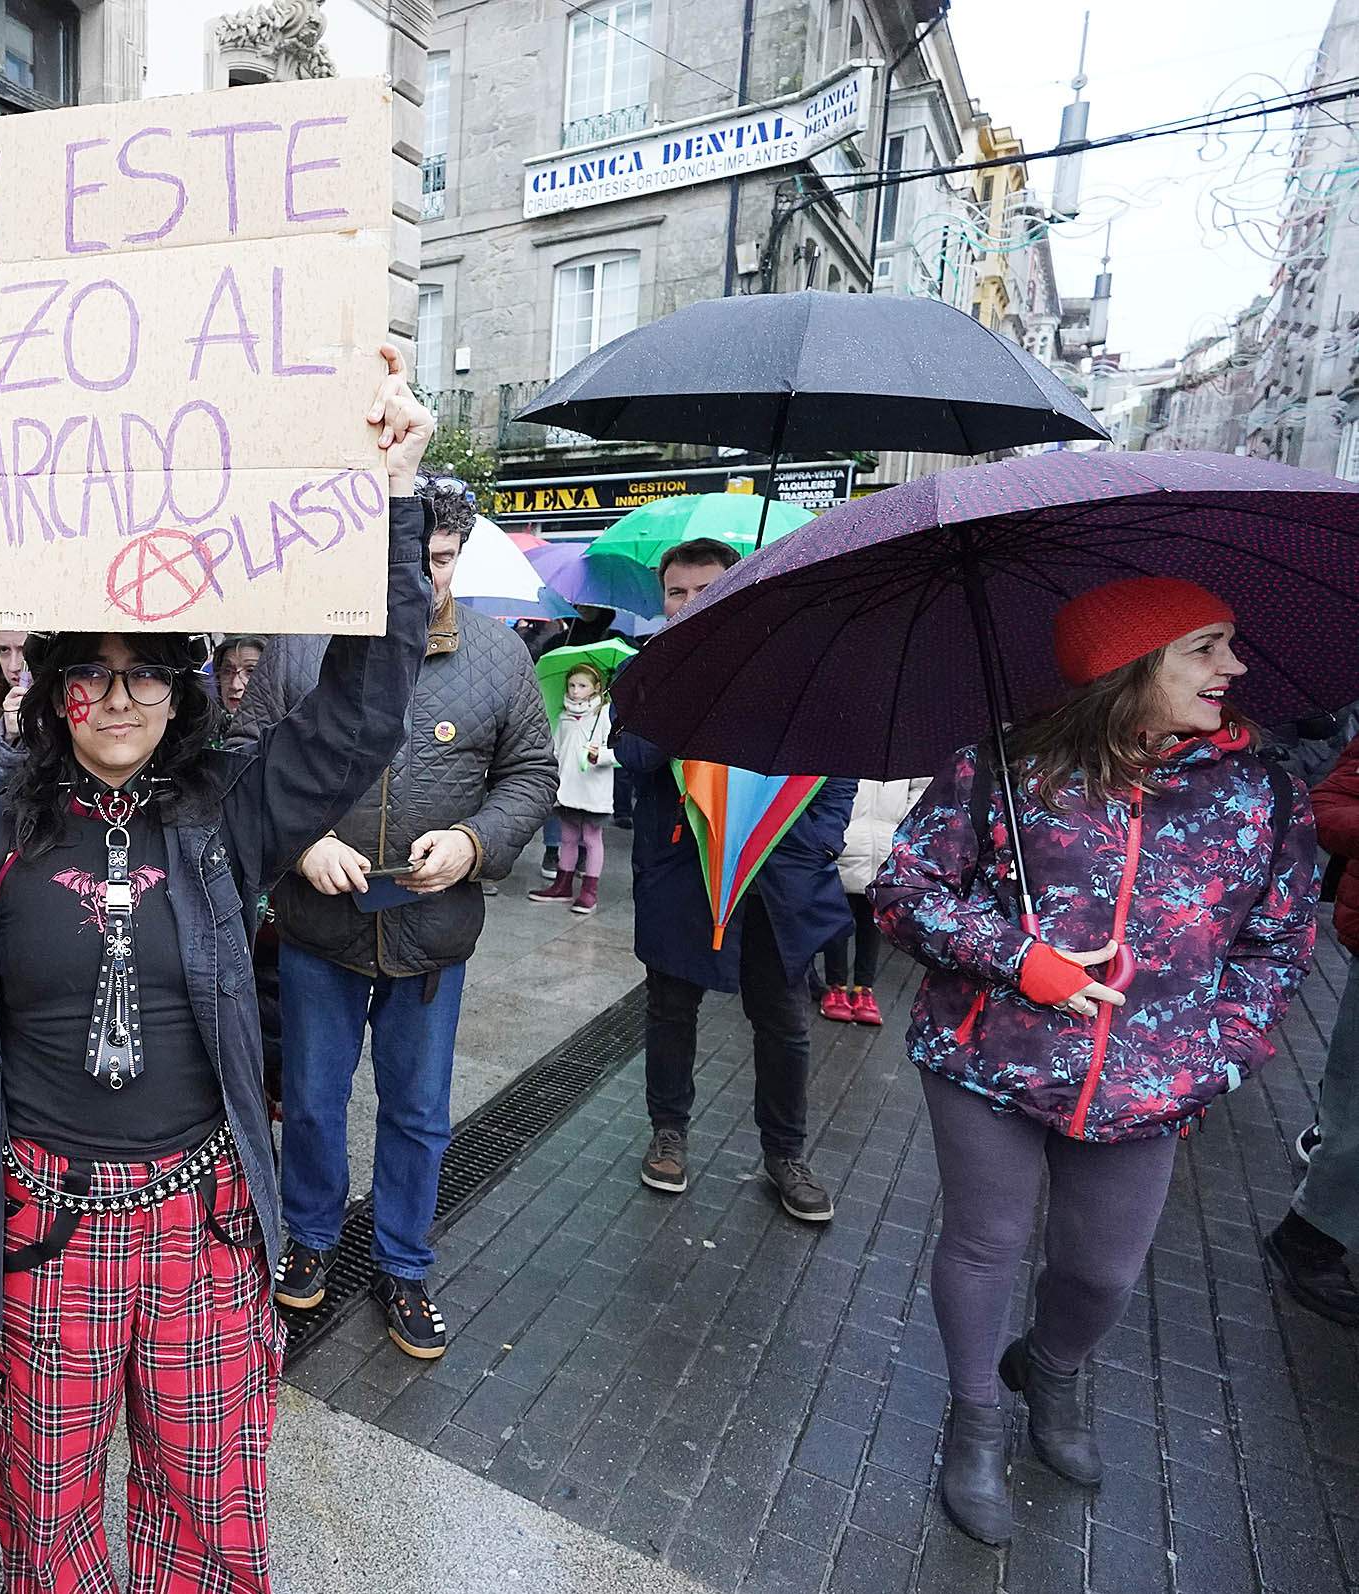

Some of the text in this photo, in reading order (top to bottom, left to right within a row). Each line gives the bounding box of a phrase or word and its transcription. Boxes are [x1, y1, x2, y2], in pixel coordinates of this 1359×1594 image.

[806, 80, 858, 119] CLINICA
[804, 101, 857, 138] DENTAL
[532, 117, 794, 193] CLINICA DENTAL
[64, 116, 349, 254] ESTE
[183, 265, 337, 382] AL
[629, 481, 687, 494] GESTION
[778, 480, 836, 491] ALQUILERES
[779, 490, 834, 499] TRASPASOS
